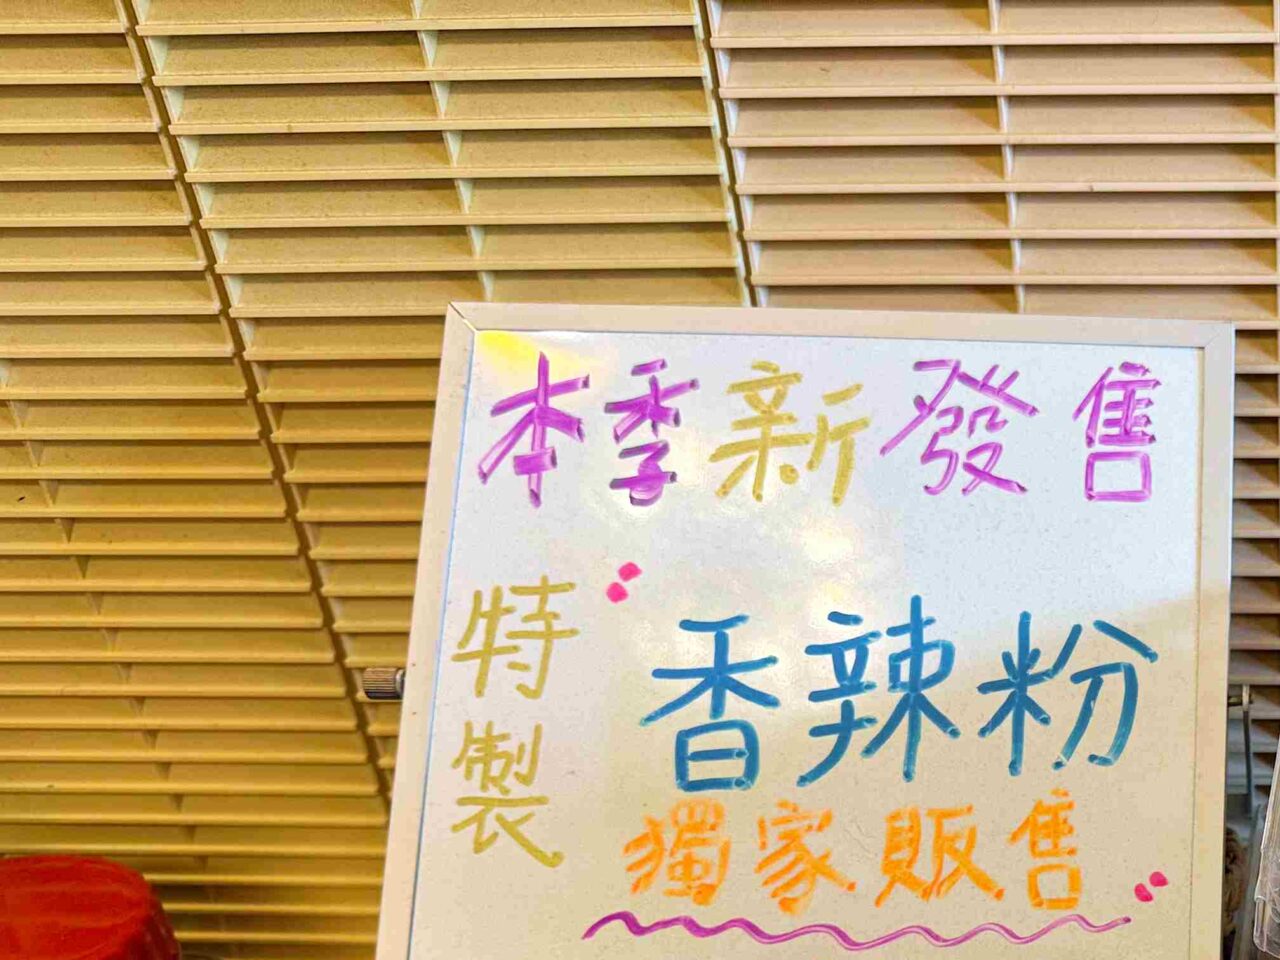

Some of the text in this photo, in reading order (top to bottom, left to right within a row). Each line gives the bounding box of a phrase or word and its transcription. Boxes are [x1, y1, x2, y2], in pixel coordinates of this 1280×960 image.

[477, 350, 1161, 508] 本季新發售
[450, 573, 579, 869] 特製
[640, 594, 1160, 793] 香辣粉
[622, 788, 1084, 916] 獨家販售
